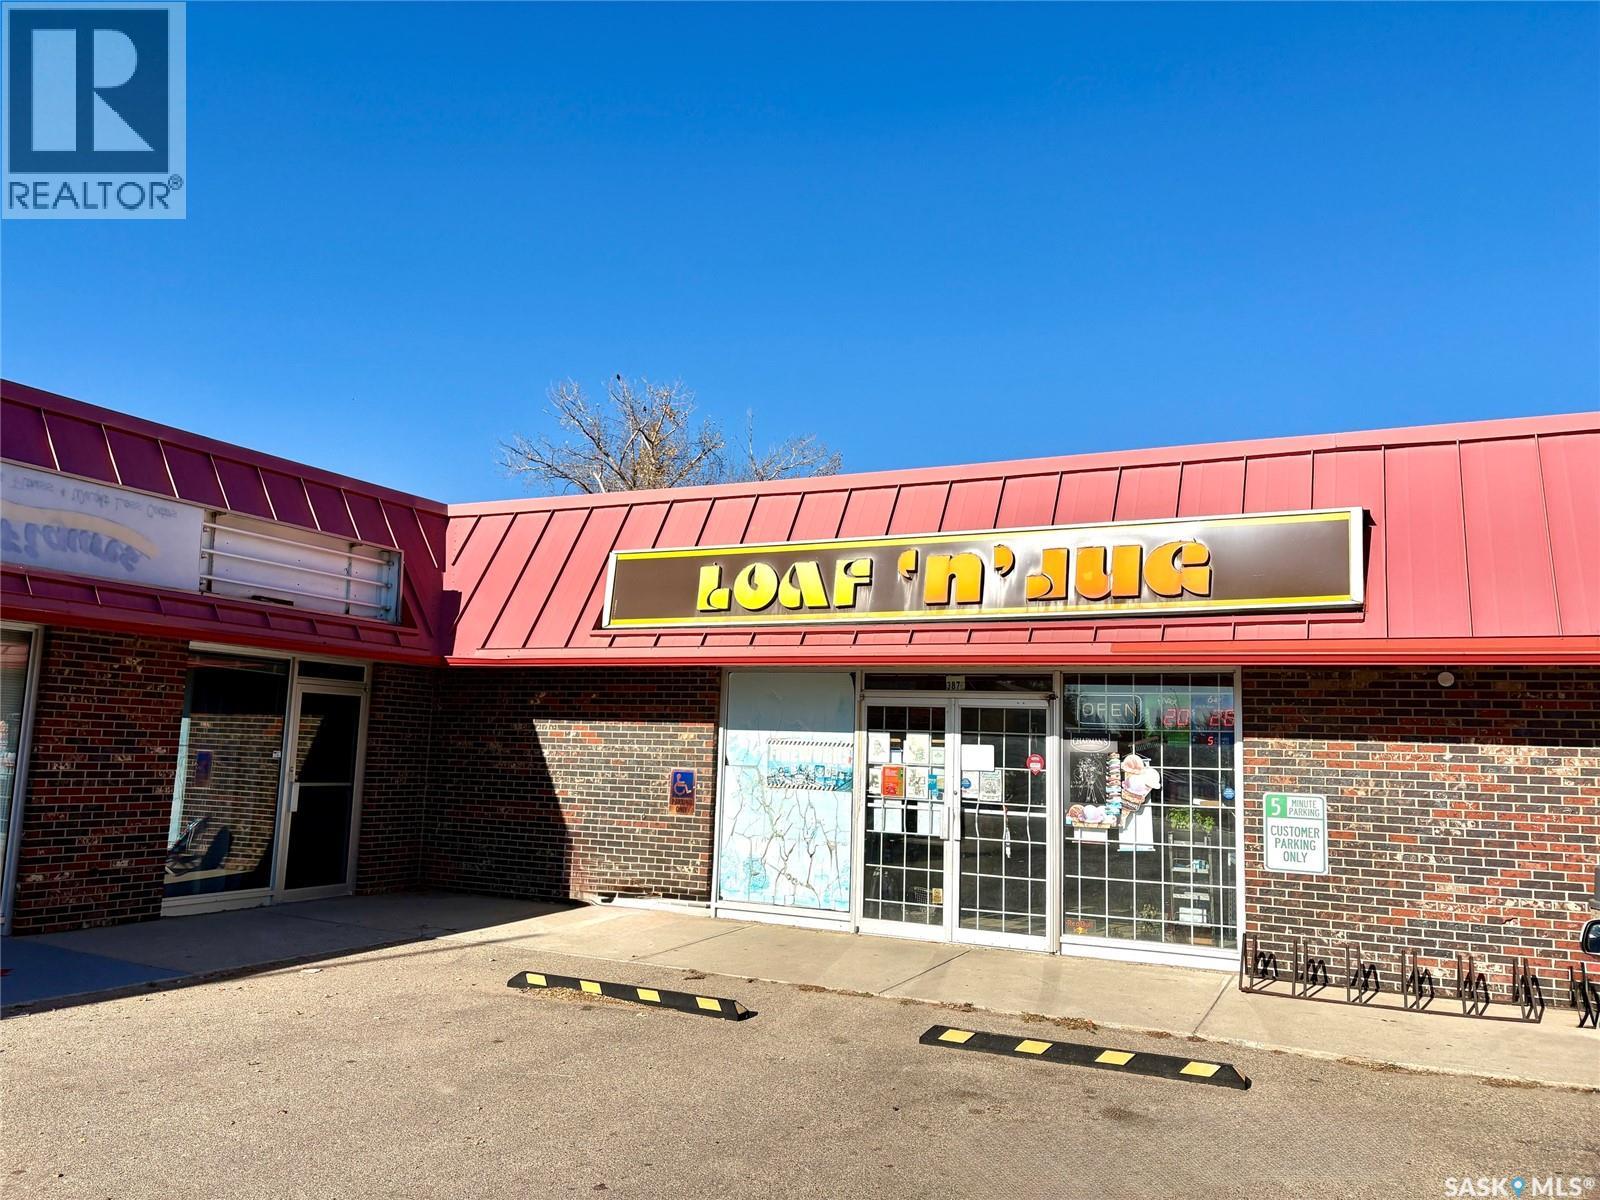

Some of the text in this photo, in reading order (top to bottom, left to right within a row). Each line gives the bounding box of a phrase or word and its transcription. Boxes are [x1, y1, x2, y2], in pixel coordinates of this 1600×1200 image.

[696, 557, 874, 612] LOAF
[1025, 539, 1213, 601] JUG
[1082, 702, 1138, 718] OPEN
[1271, 797, 1281, 816] 5
[1291, 799, 1318, 809] MINUTE
[1288, 807, 1321, 817] PARKING
[1270, 825, 1320, 839] CUSTOMER
[1274, 837, 1316, 851] PARKING
[1283, 850, 1308, 863] ONLY
